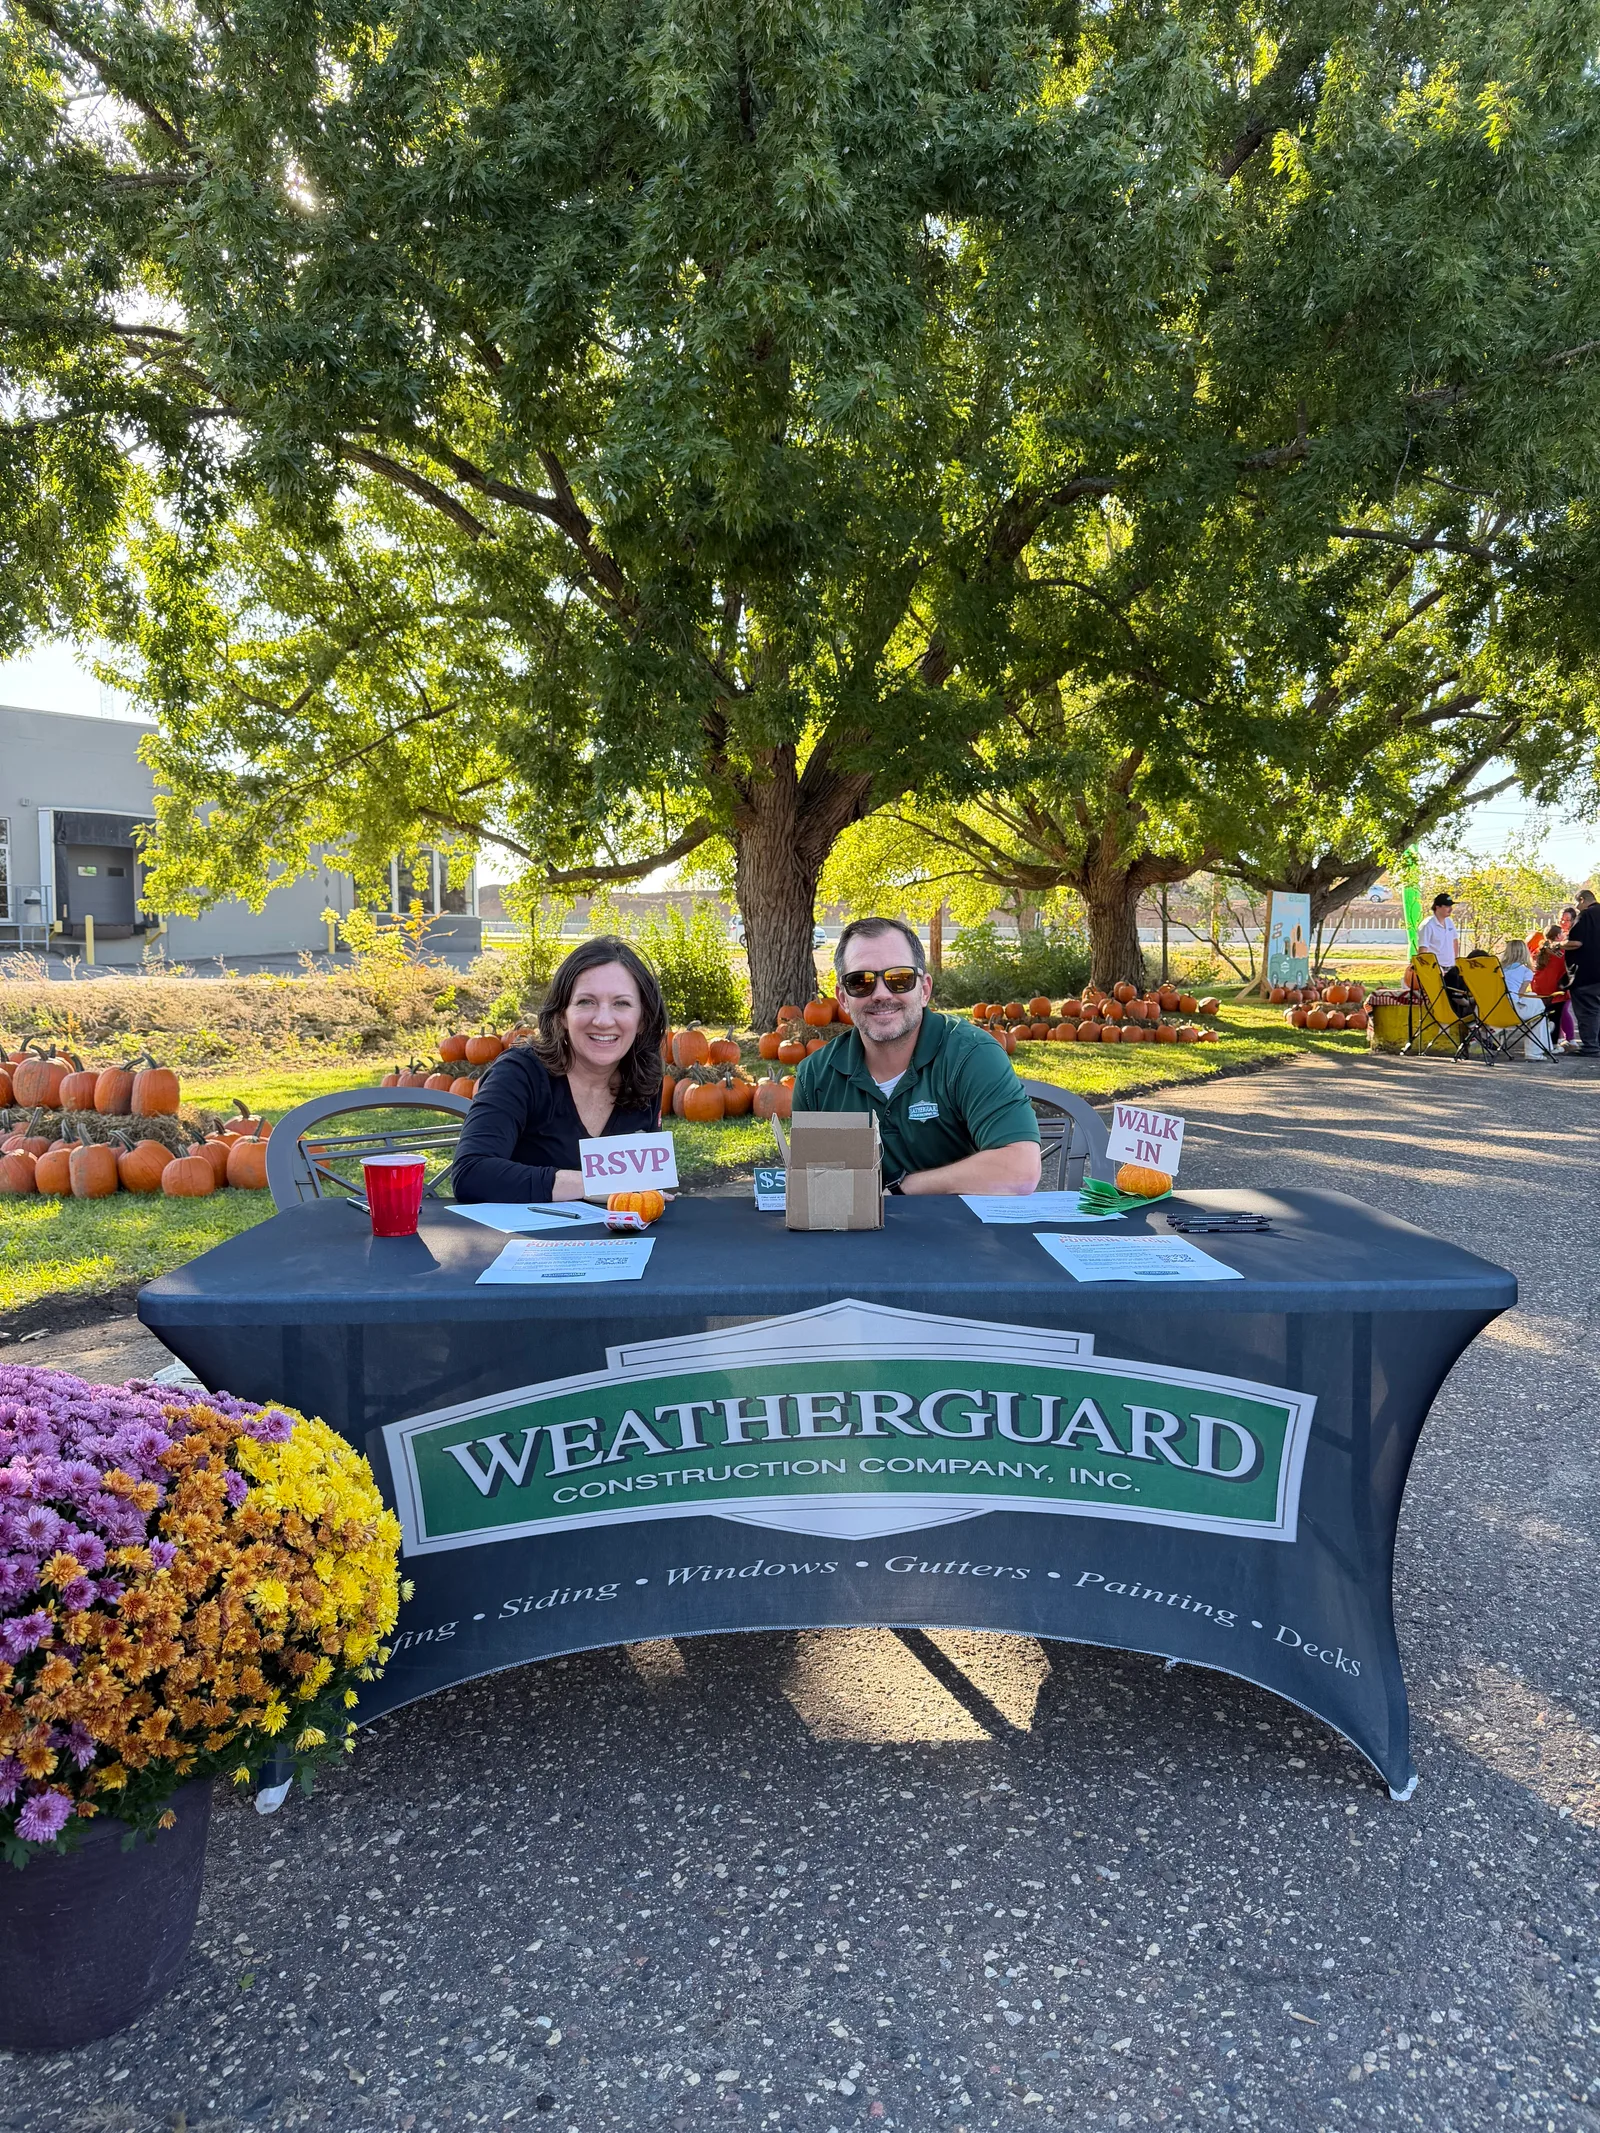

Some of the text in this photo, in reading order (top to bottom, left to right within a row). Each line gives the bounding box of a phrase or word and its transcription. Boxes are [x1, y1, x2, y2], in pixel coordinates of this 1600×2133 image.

[1117, 1106, 1180, 1142] WALK
[582, 1147, 670, 1179] RSVP
[1124, 1139, 1163, 1165] -IN
[442, 1389, 1260, 1497] WEATHERGUARD
[552, 1457, 1142, 1505] CONSTRUCTION COMPANY, INC.
[388, 1555, 1361, 1677] fing Siding Windows Gutters Painting Decks
